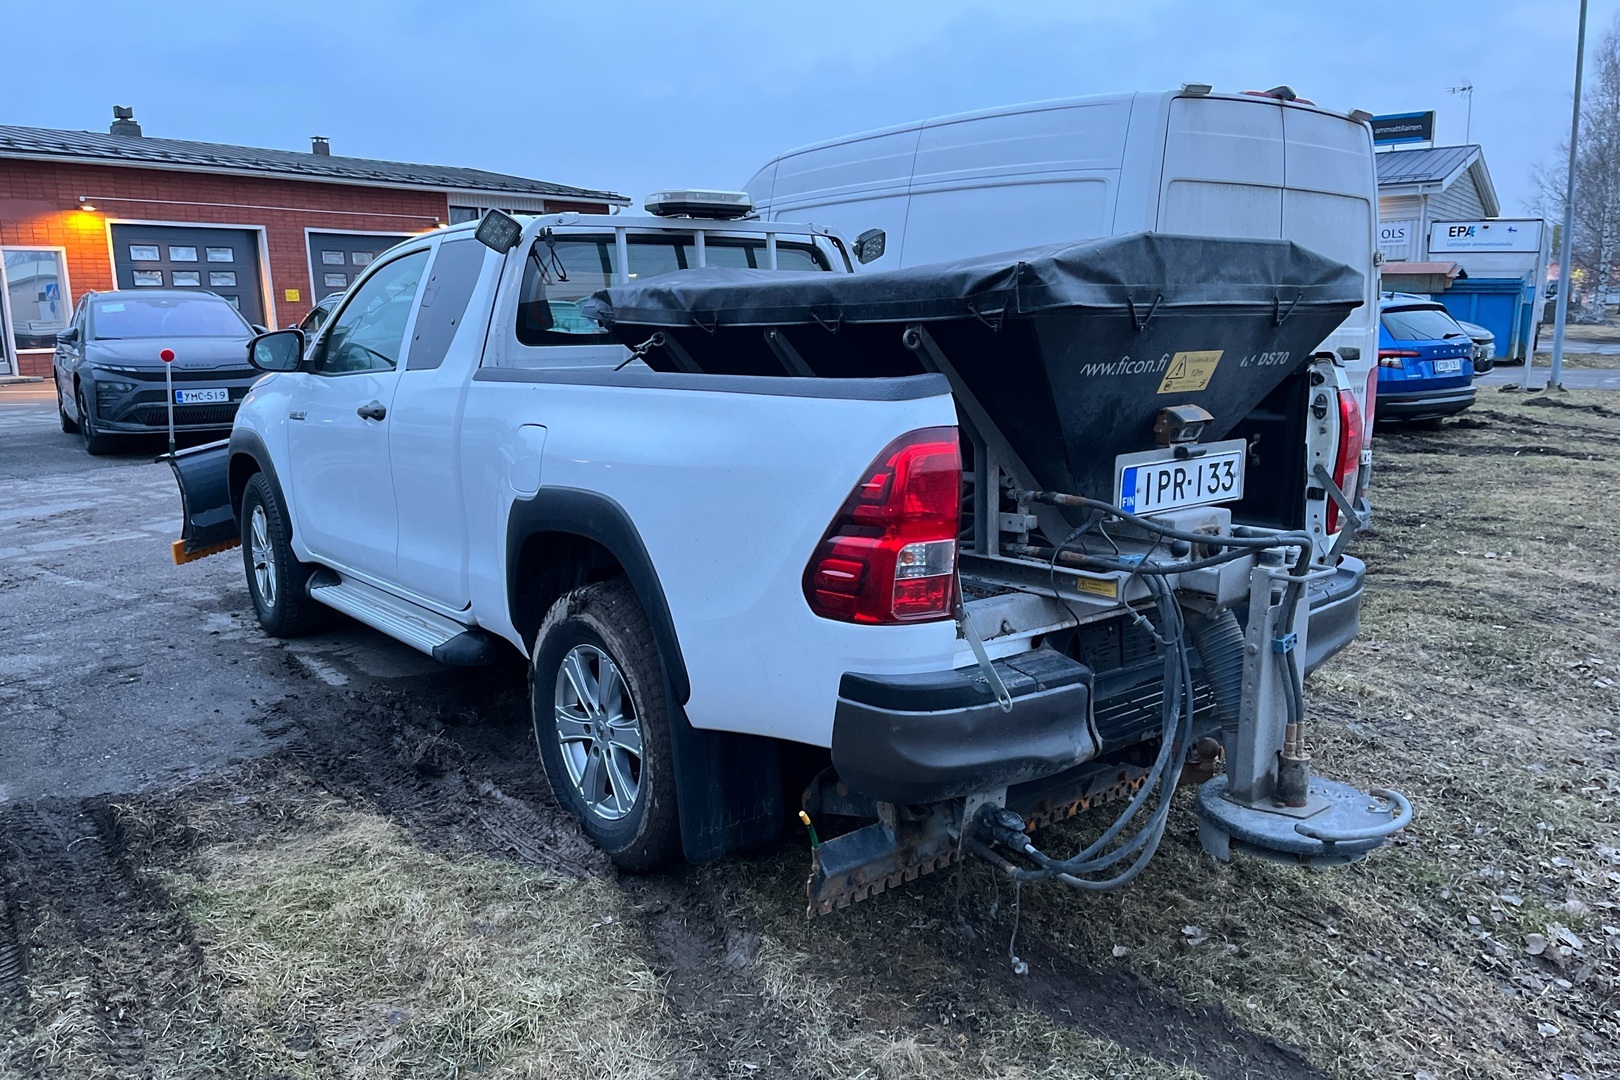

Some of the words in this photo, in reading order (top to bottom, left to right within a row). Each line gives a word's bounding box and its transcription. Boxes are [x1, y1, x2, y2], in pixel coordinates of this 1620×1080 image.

[1080, 353, 1170, 377] ww.ficon.fi
[1257, 351, 1290, 366] DS70
[184, 391, 226, 402] YMC-519
[1122, 496, 1134, 507] FIN
[1145, 460, 1235, 506] IPR-133
